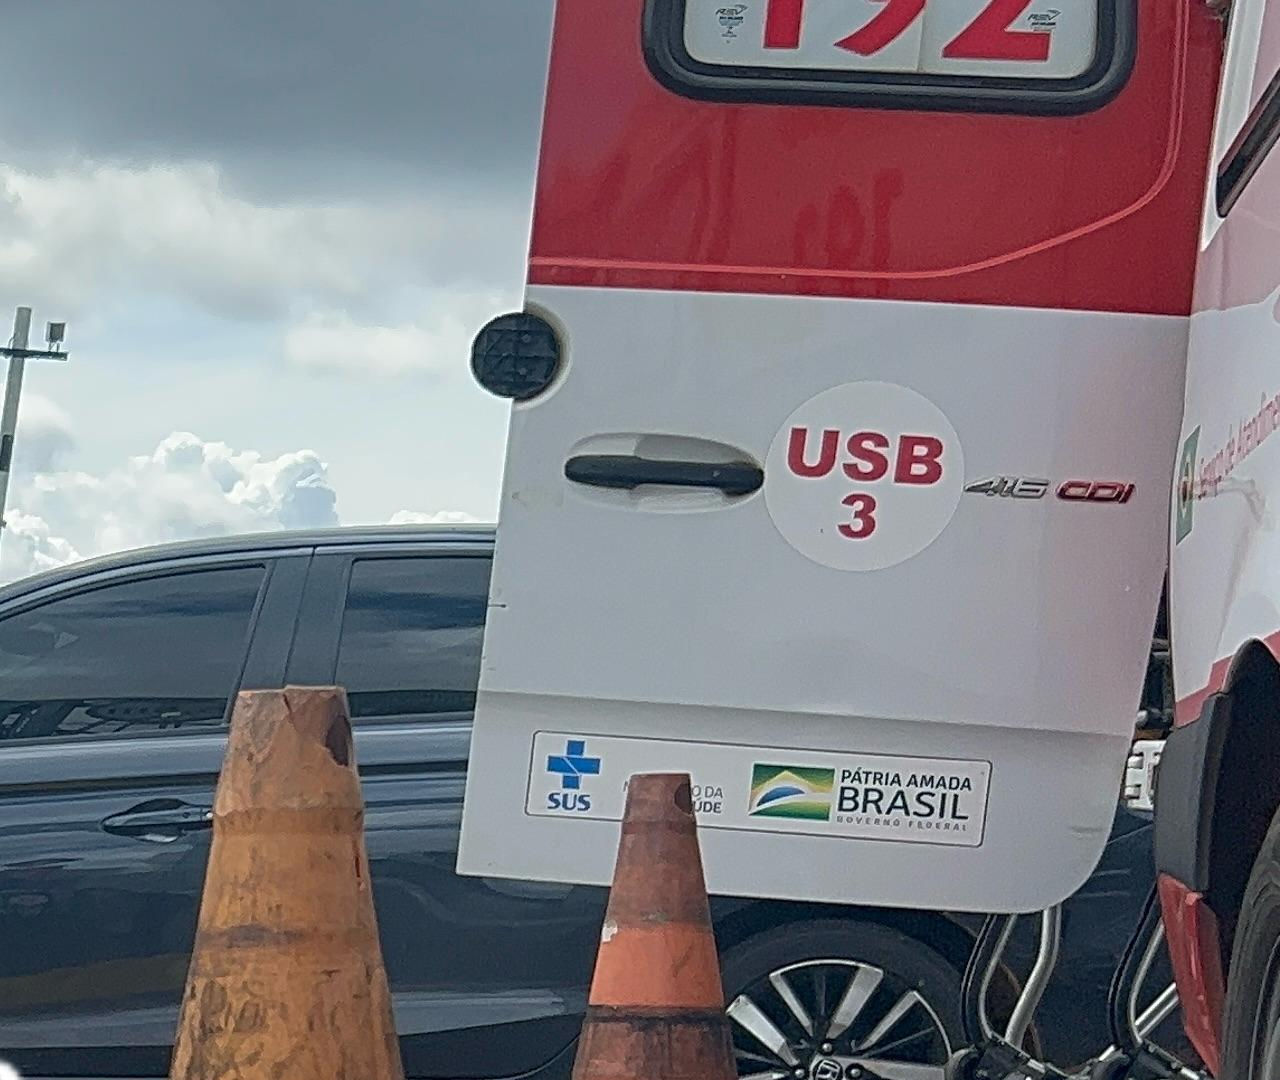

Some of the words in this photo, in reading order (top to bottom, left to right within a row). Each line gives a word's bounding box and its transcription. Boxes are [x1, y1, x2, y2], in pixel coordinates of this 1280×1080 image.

[787, 427, 943, 486] USB
[1055, 479, 1136, 504] CDI
[837, 492, 877, 540] 3
[840, 767, 902, 788] PÁTRIA
[906, 773, 972, 792] AMADA
[547, 792, 591, 812] SUS
[692, 797, 722, 814] ÚDE
[837, 786, 970, 821] BRASIL
[836, 815, 901, 828] GOVERNO
